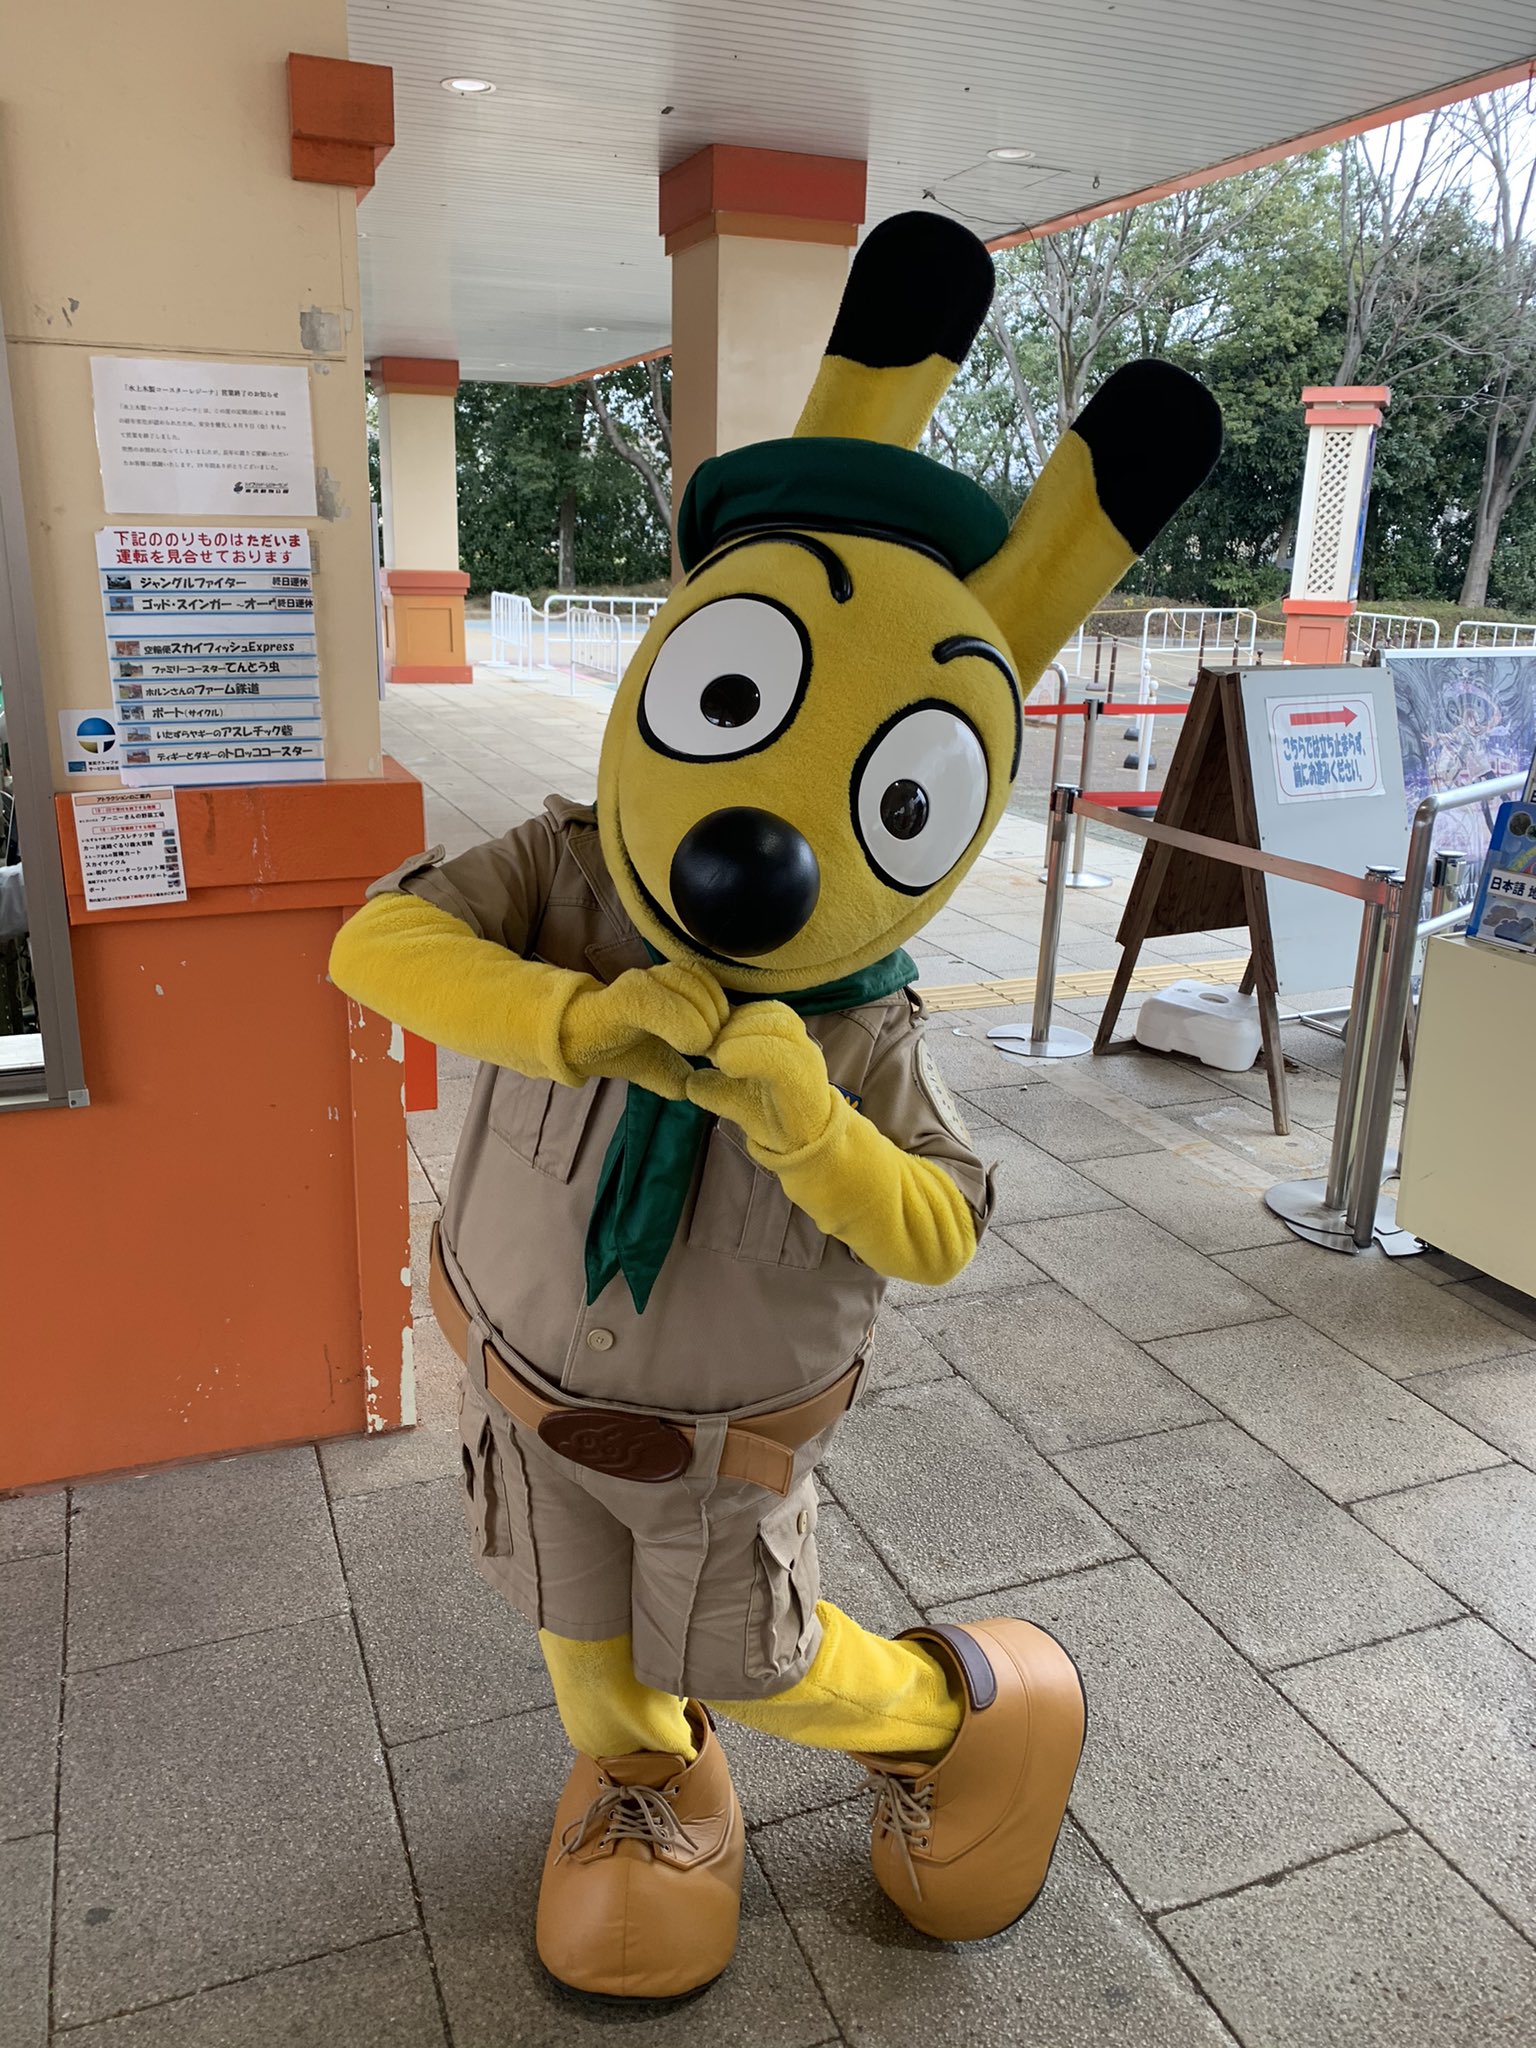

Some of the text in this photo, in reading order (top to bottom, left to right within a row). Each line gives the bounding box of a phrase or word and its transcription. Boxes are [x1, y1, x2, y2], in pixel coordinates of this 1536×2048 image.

[114, 531, 301, 548] 下記ののりものはただいま
[116, 549, 292, 565] 運転を見合せております
[140, 576, 246, 589] ジャングルファイター
[152, 661, 280, 674] ファミリーコースターてんとう虫
[146, 683, 260, 697] ホルンさんのファーム鉄道
[1283, 731, 1366, 761] こちらでは立ち止まらず、
[1293, 759, 1362, 788] 前にお進みください。
[1490, 876, 1526, 896] 日本語
